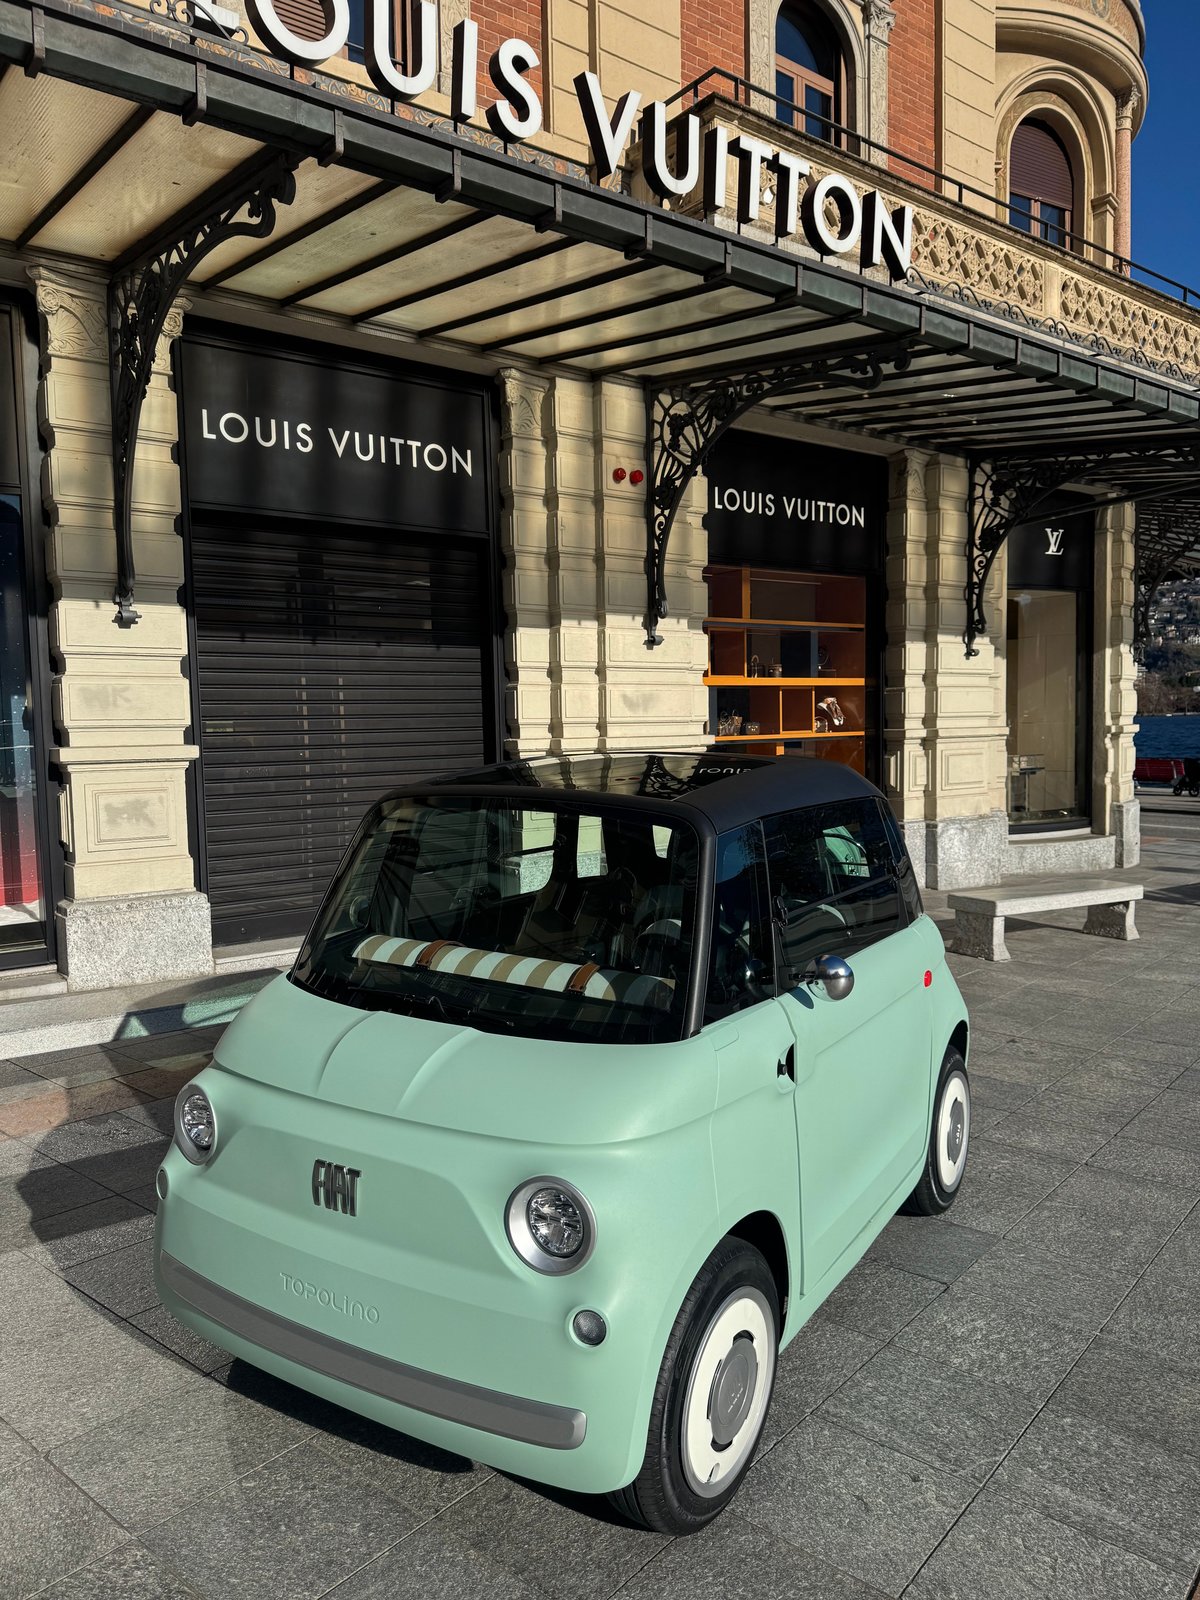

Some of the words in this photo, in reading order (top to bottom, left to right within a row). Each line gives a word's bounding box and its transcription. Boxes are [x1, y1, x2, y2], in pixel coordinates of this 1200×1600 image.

[573, 70, 913, 281] VUITTON
[201, 408, 314, 453] LOUIS
[327, 427, 473, 477] VUITTON
[714, 486, 775, 516] LOUIS
[782, 496, 866, 528] VUITTON
[312, 1158, 362, 1217] FIAT
